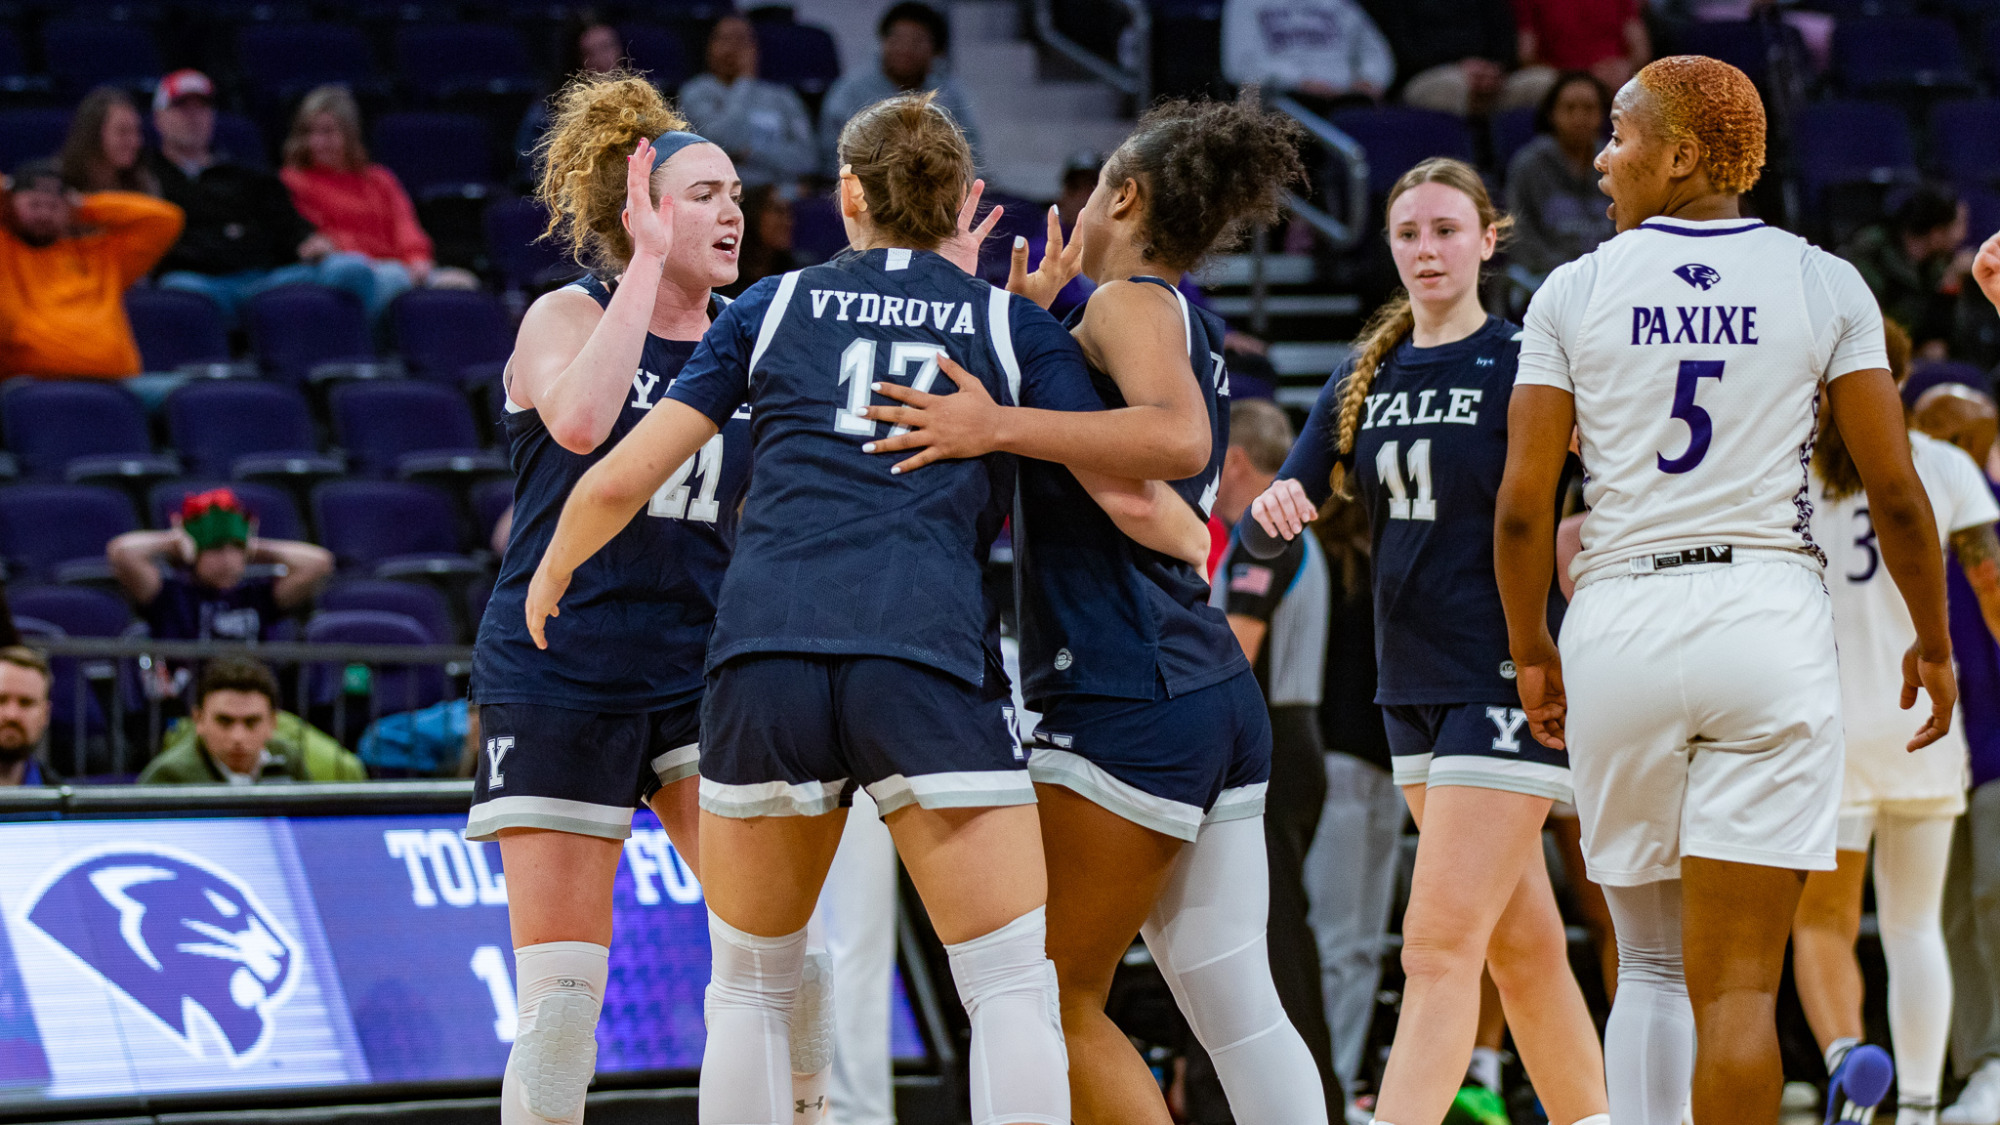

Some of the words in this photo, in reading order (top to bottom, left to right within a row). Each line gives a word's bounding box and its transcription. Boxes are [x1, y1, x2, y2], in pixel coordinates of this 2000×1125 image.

[810, 289, 975, 335] VYDROVA
[1630, 305, 1759, 345] PAXIXE
[834, 337, 946, 438] 17
[1362, 387, 1483, 430] YALE
[1656, 360, 1726, 475] 5
[647, 434, 724, 523] 21
[1375, 439, 1437, 521] 11
[1485, 706, 1528, 753] Y
[487, 736, 515, 790] Y
[622, 829, 703, 905] FO
